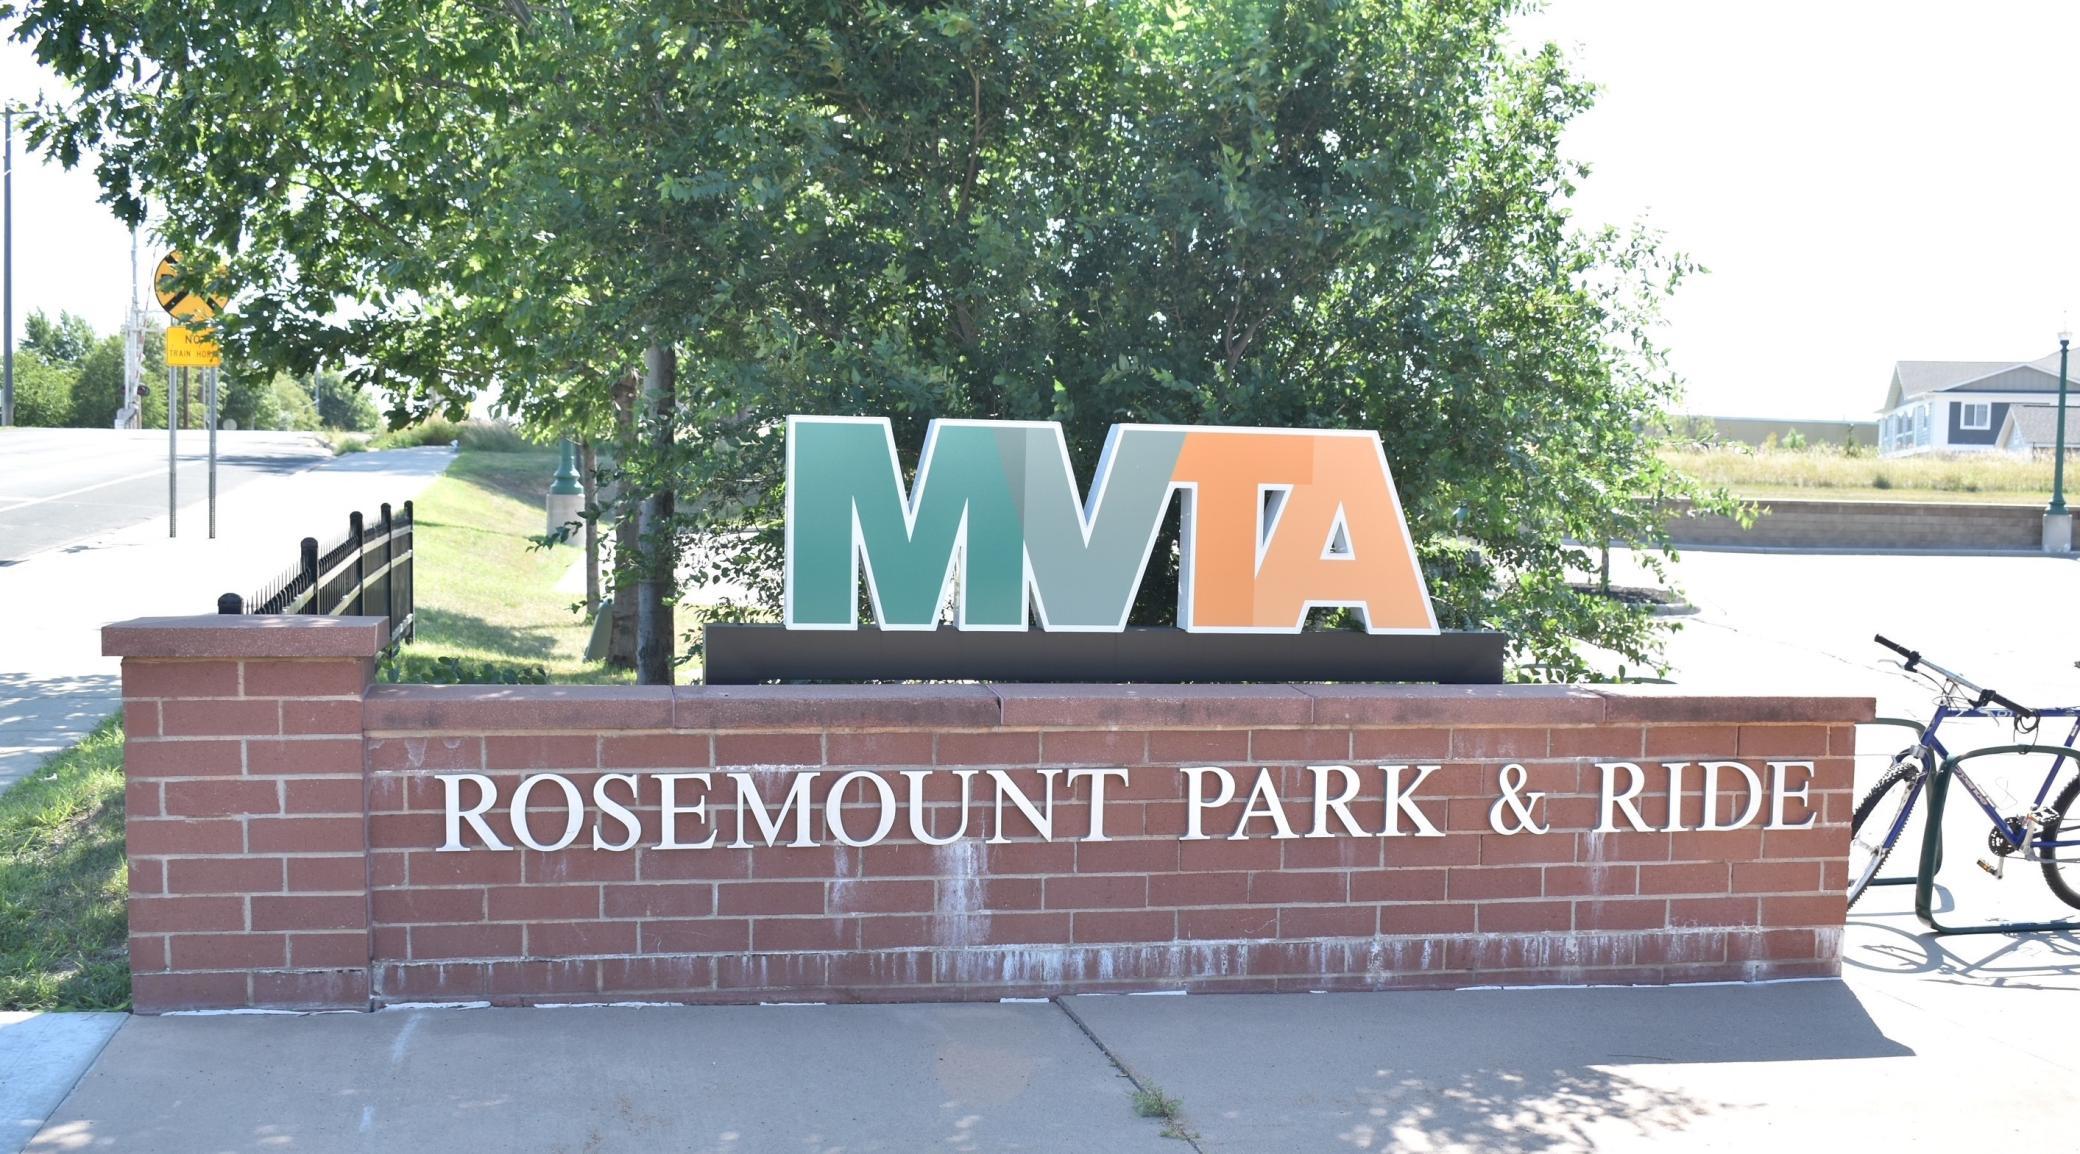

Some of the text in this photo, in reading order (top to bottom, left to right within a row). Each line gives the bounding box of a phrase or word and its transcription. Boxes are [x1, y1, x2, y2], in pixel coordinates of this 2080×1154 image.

[169, 349, 218, 358] TRAIN HOR
[185, 335, 200, 344] NO
[785, 415, 1440, 635] MVTA
[434, 761, 1818, 852] ROSEMOUNT PARK & RIDE
